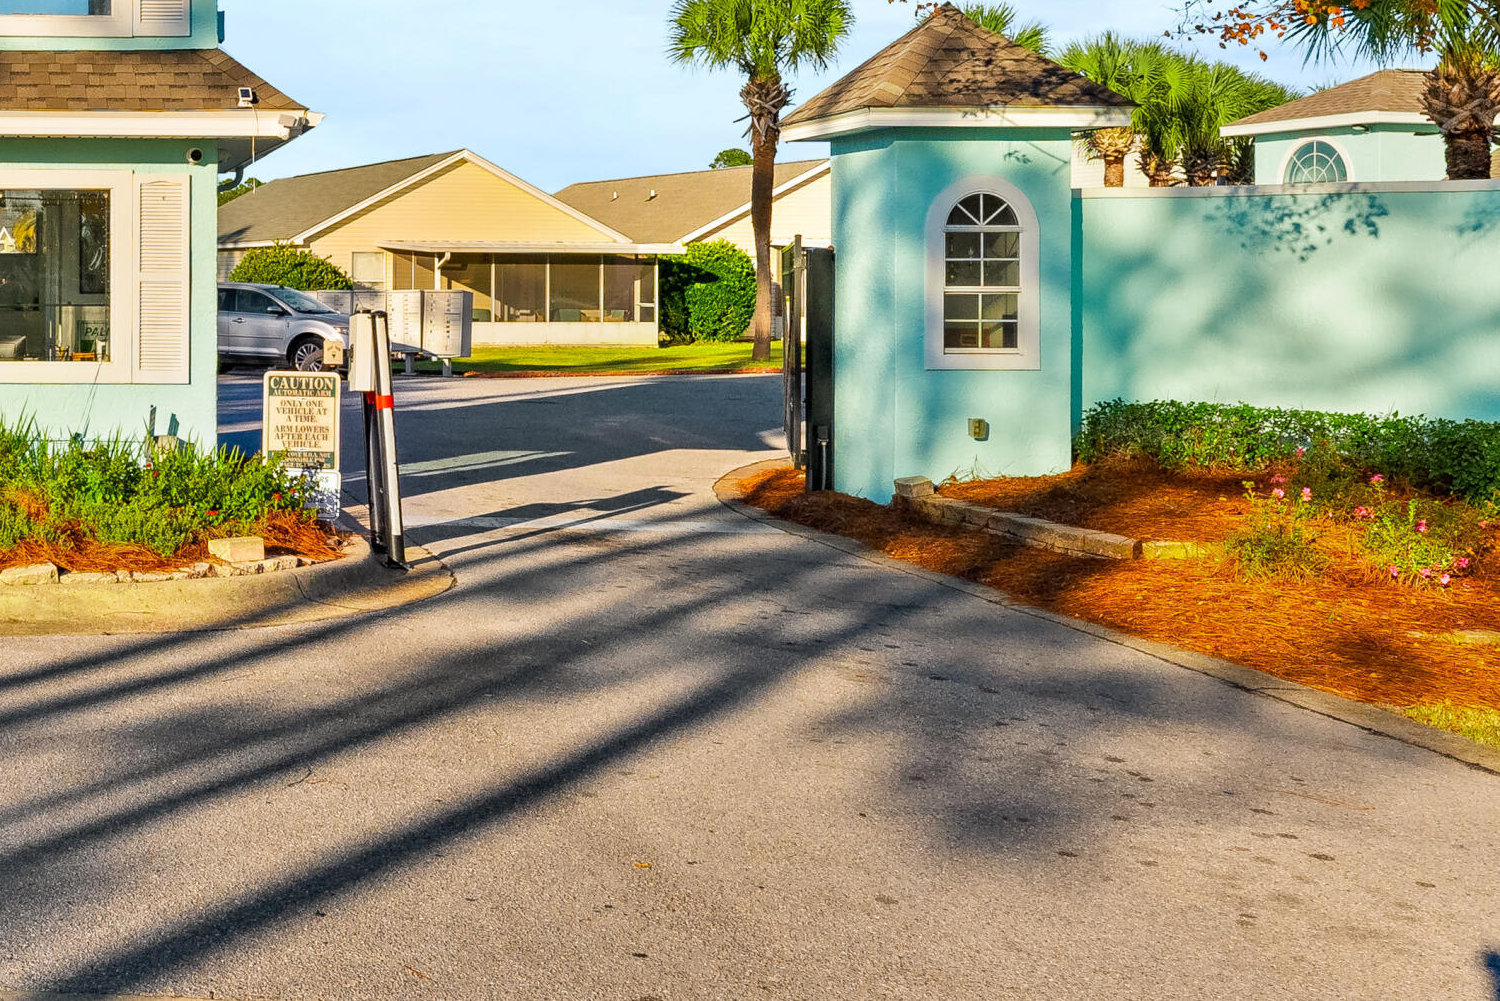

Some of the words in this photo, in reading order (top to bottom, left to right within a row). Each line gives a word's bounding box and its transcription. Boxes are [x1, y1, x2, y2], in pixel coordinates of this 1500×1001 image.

[270, 377, 333, 389] CAUTION
[276, 407, 314, 415] VEHICLE
[286, 415, 293, 423] A
[305, 433, 329, 441] EACH
